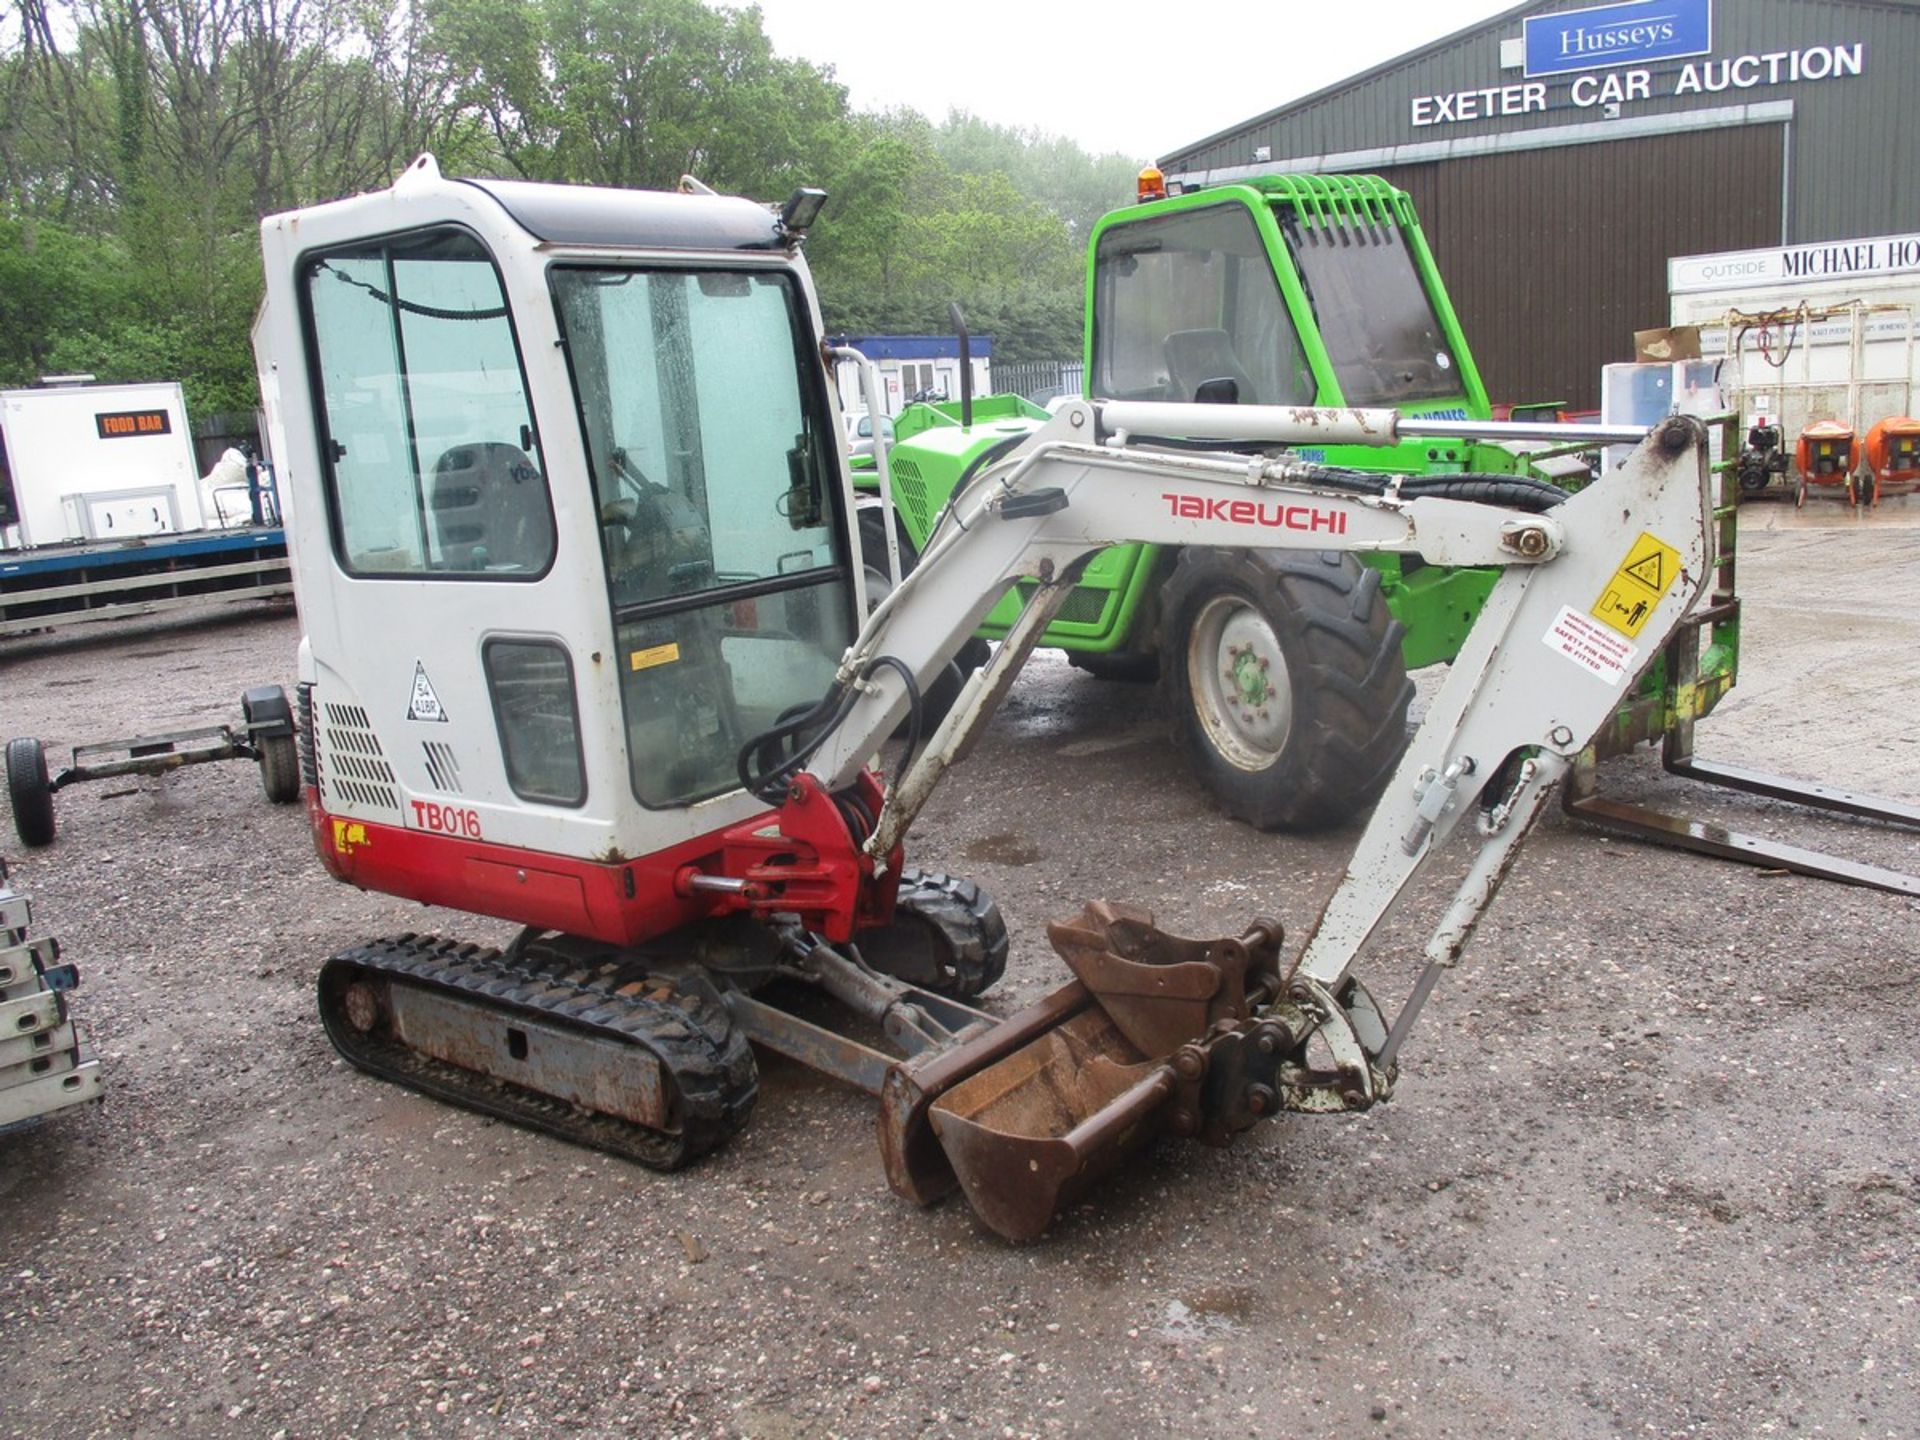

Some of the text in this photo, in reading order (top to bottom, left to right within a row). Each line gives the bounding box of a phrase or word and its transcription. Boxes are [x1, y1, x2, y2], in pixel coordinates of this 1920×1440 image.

[1559, 22, 1674, 55] Husseys
[1411, 43, 1863, 127] EXETER CAR AUCTION
[1782, 245, 1880, 277] MICHAEL
[103, 414, 164, 434] FOOD BAR
[1554, 626, 1583, 647] SAFETY
[1584, 645, 1598, 657] PIN
[1598, 653, 1621, 670] MUST
[1574, 650, 1601, 670] FITTED
[410, 799, 482, 838] TB016
